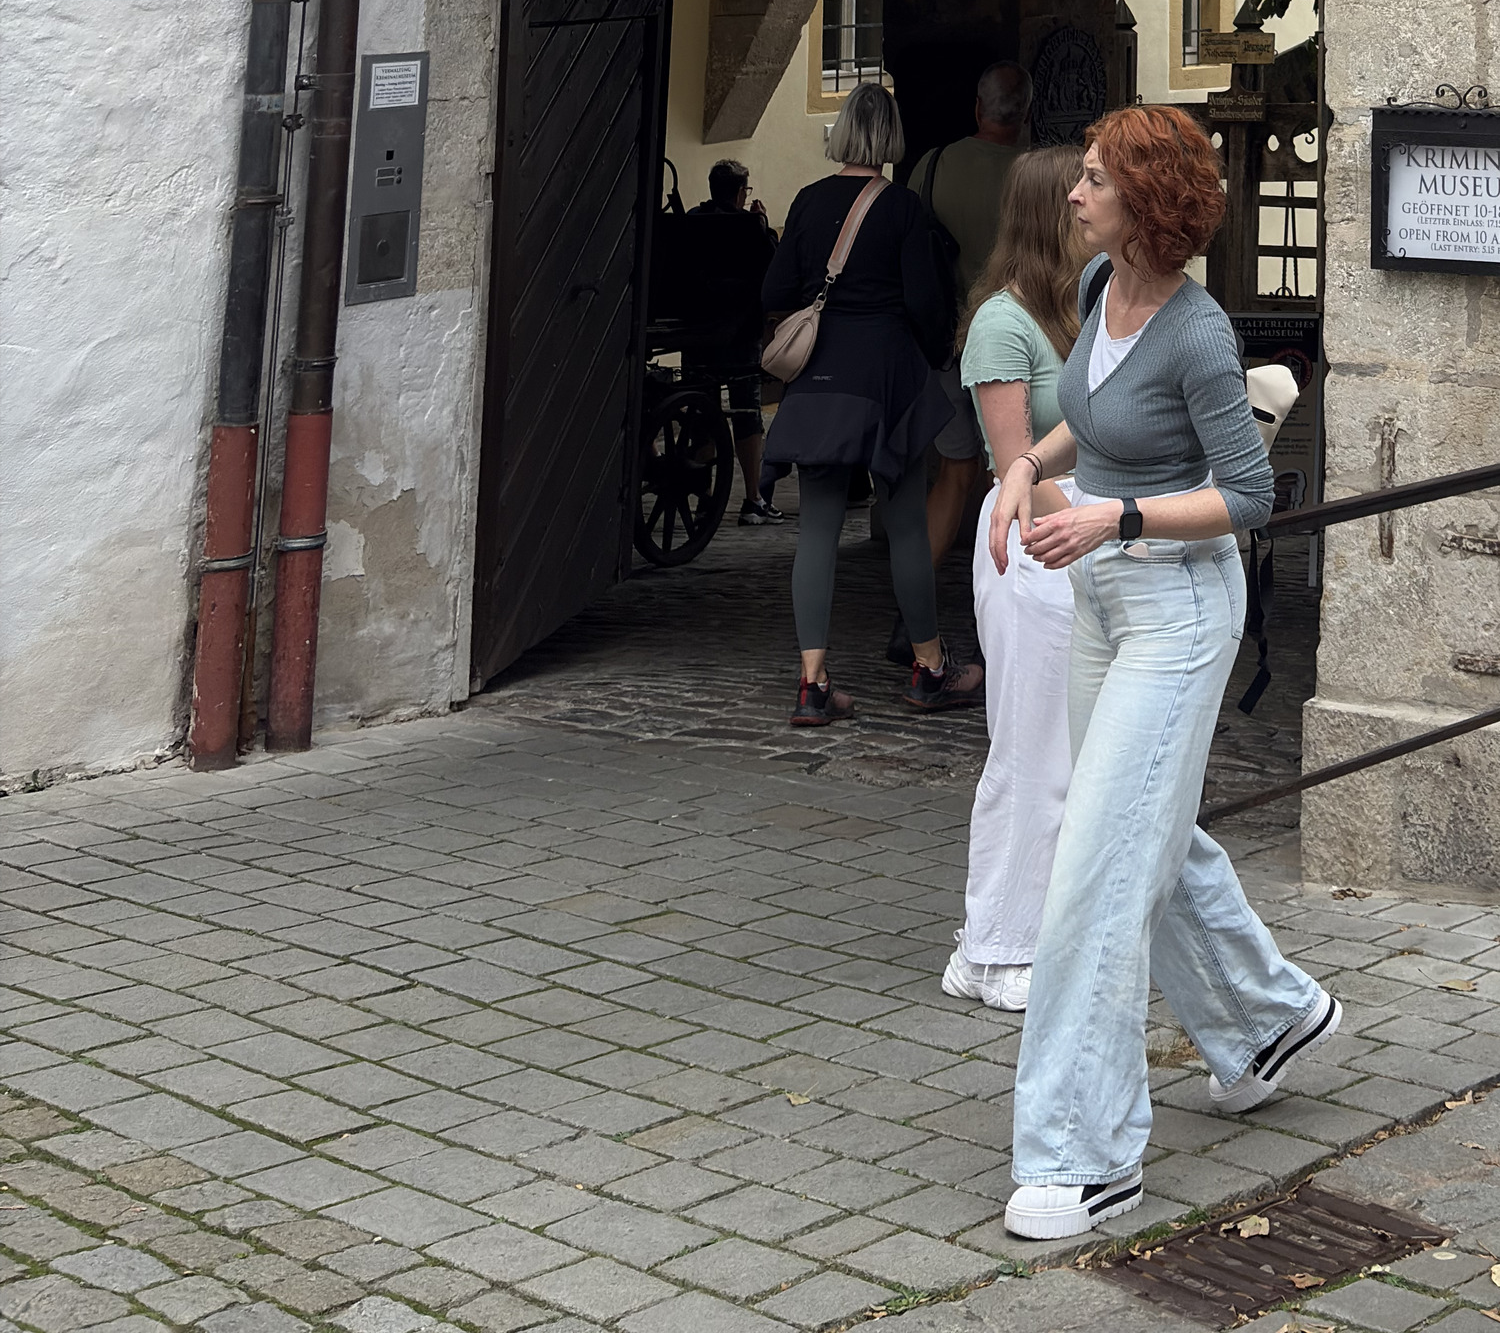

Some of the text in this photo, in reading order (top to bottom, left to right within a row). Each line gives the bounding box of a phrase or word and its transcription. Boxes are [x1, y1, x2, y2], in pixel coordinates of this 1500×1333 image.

[1402, 201, 1469, 217] GEÖFFNET
[1399, 228, 1431, 241] OPEN
[1436, 230, 1471, 242] FROM
[1476, 231, 1487, 244] 10
